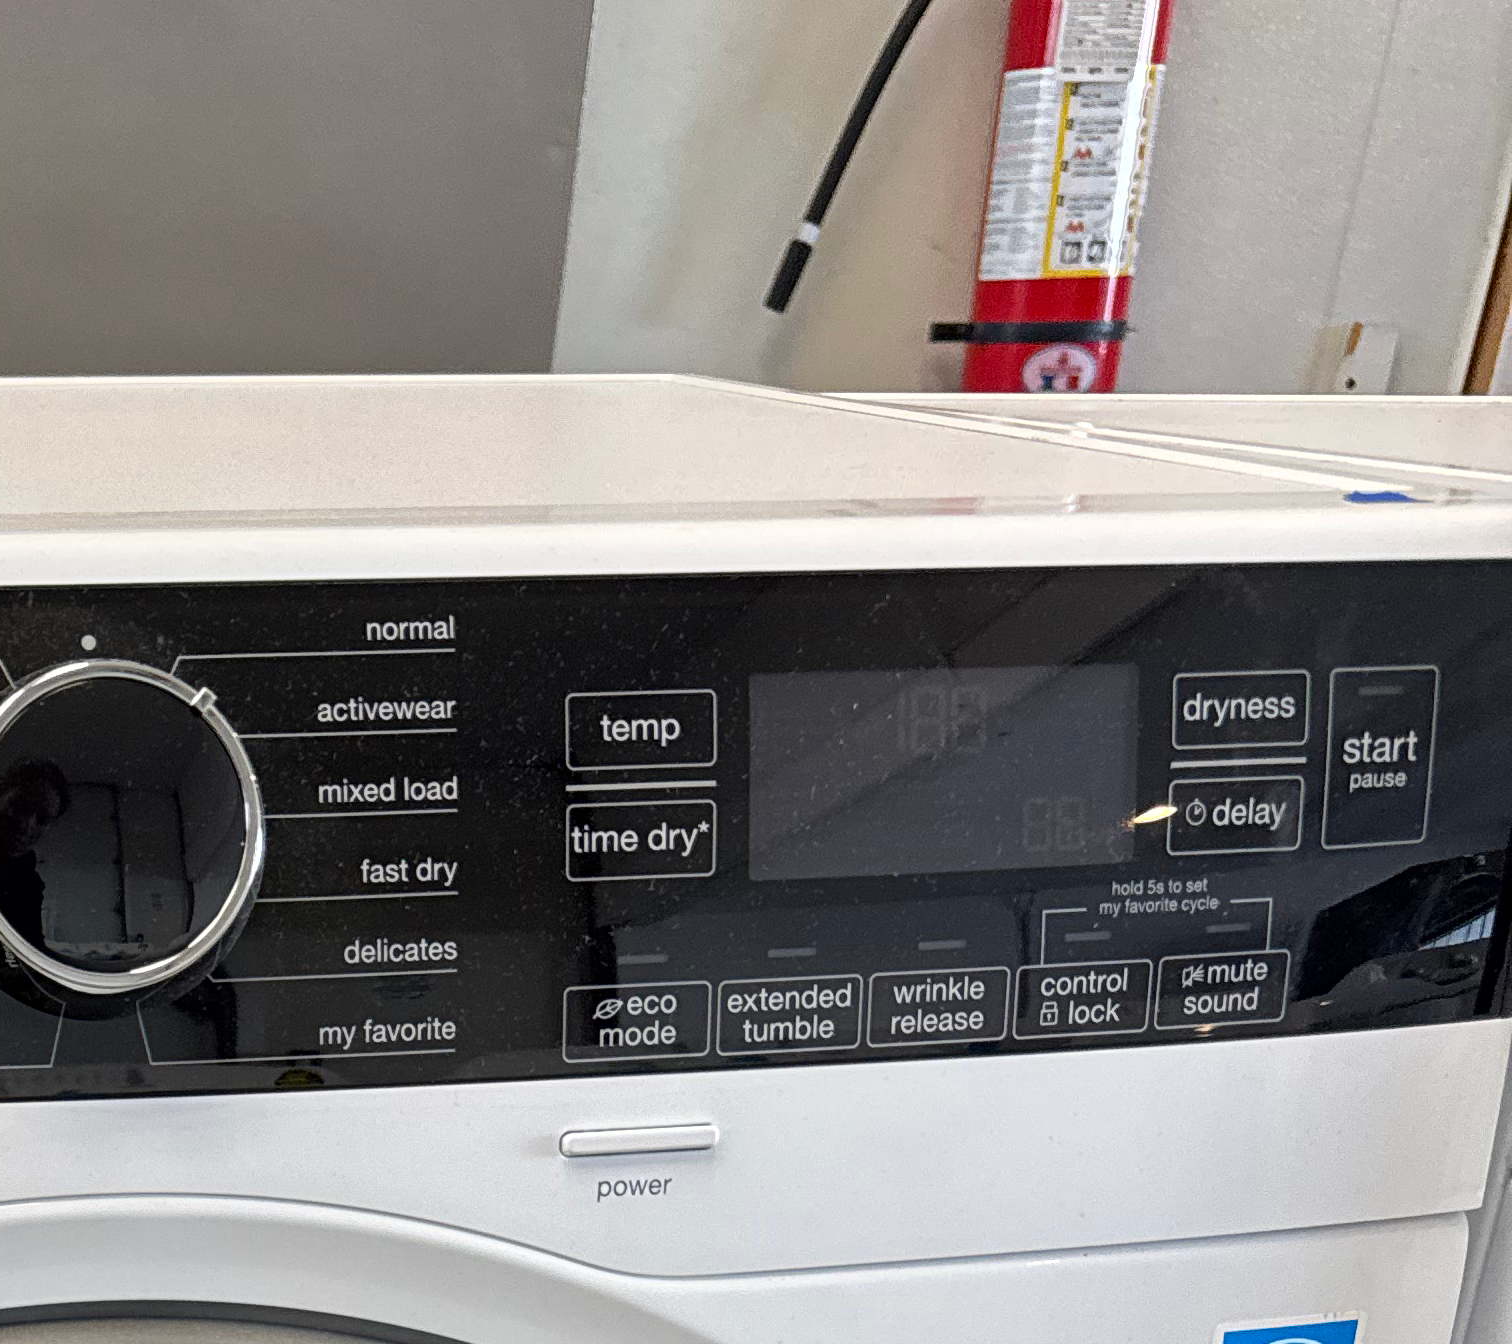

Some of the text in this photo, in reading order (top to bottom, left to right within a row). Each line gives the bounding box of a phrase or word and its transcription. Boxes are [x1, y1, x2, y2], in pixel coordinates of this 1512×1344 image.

[367, 615, 454, 640] normal
[318, 699, 456, 722] activewear
[1184, 693, 1295, 727] dryness
[600, 715, 680, 747] temp
[1343, 731, 1417, 763] start
[319, 776, 457, 803] mixed load
[1350, 772, 1407, 792] pause
[1213, 797, 1286, 830] delay
[571, 827, 638, 853] time
[360, 857, 457, 886] fast dry
[1112, 878, 1208, 896] hold 5s to set
[1100, 896, 1220, 918] my favorite cycle
[344, 939, 457, 963] delicates
[1041, 968, 1128, 996] control
[1207, 959, 1268, 983] mute
[728, 983, 851, 1013] extended
[894, 976, 984, 1003] wrinkle
[1184, 987, 1259, 1014] sound
[627, 995, 677, 1015] eco
[1069, 998, 1120, 1024] lock
[320, 1018, 456, 1050] my favorite
[600, 1020, 676, 1047] mode
[743, 1015, 834, 1042] tumble
[891, 1009, 984, 1034] release
[597, 1178, 672, 1202] power
